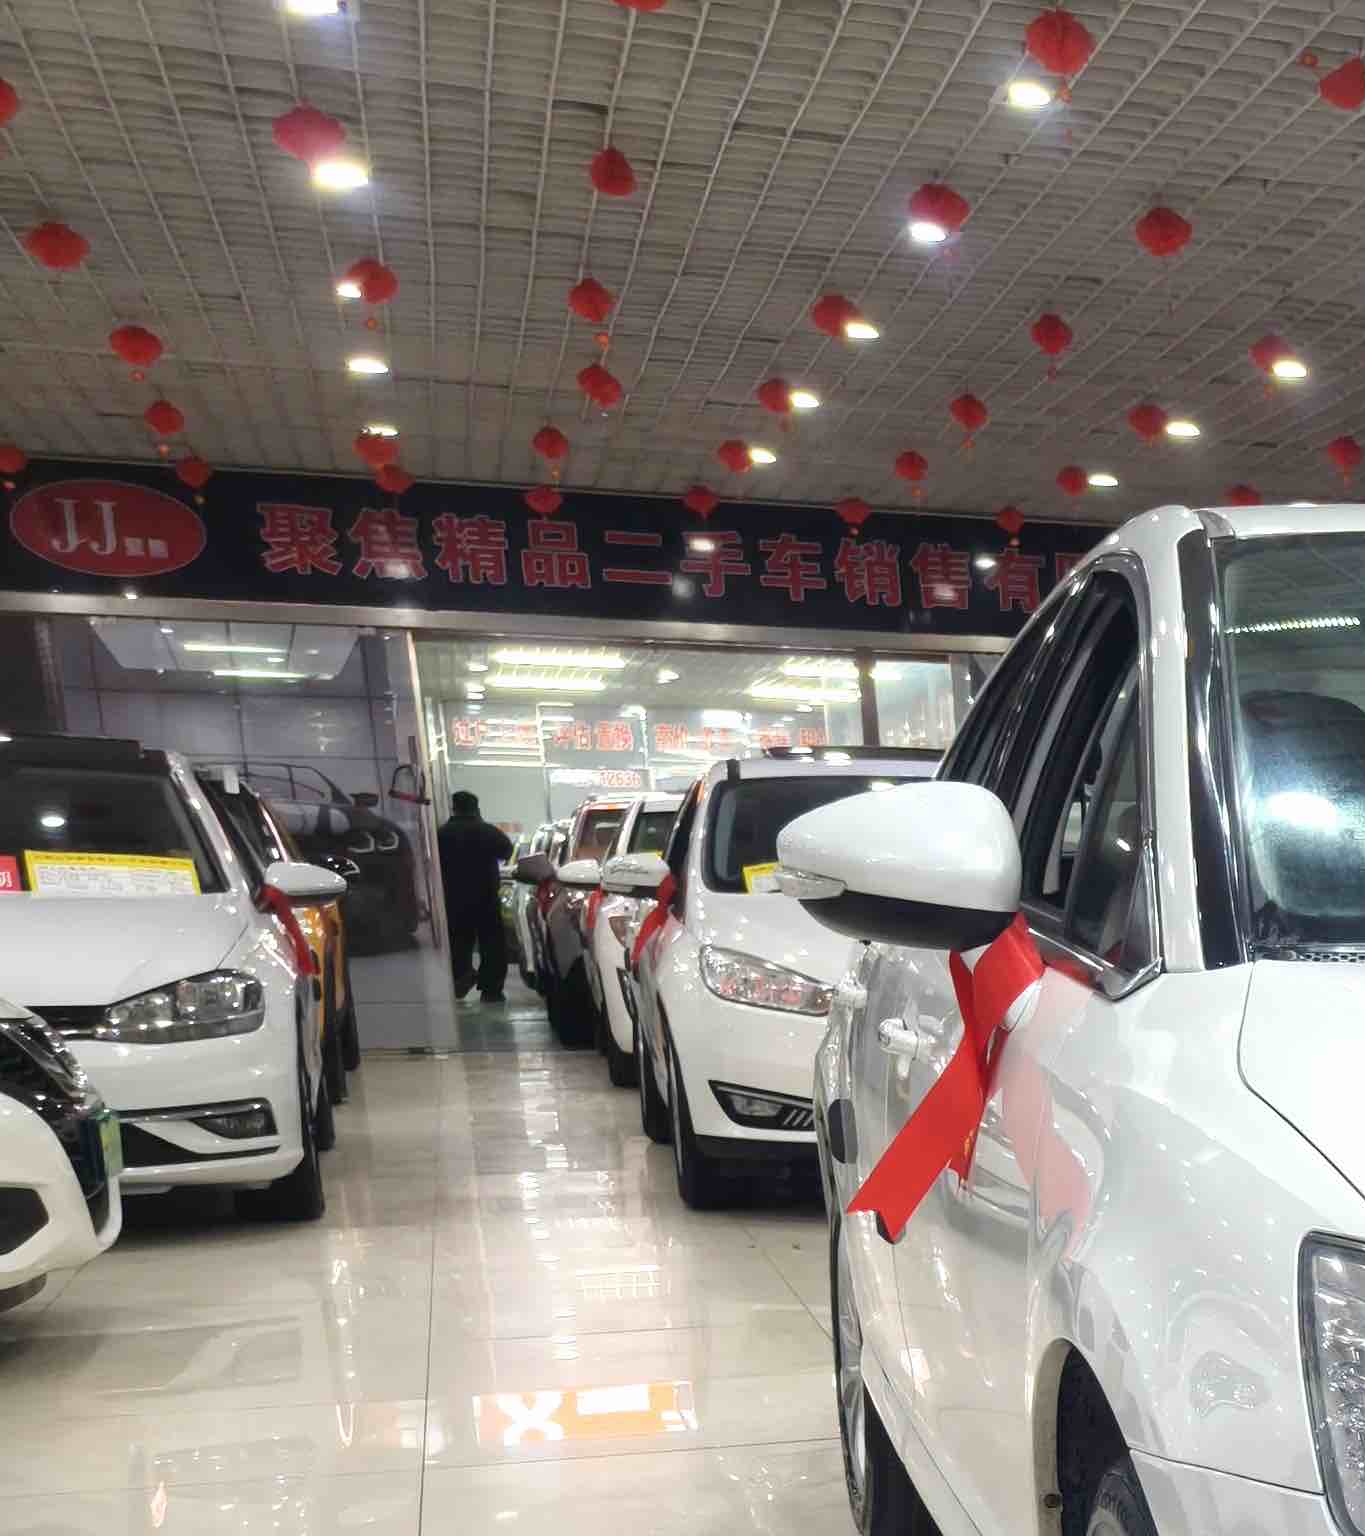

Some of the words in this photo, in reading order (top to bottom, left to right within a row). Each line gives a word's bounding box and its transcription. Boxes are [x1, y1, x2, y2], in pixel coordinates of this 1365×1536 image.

[256, 503, 1092, 613] 聚焦精品二手车销售有
